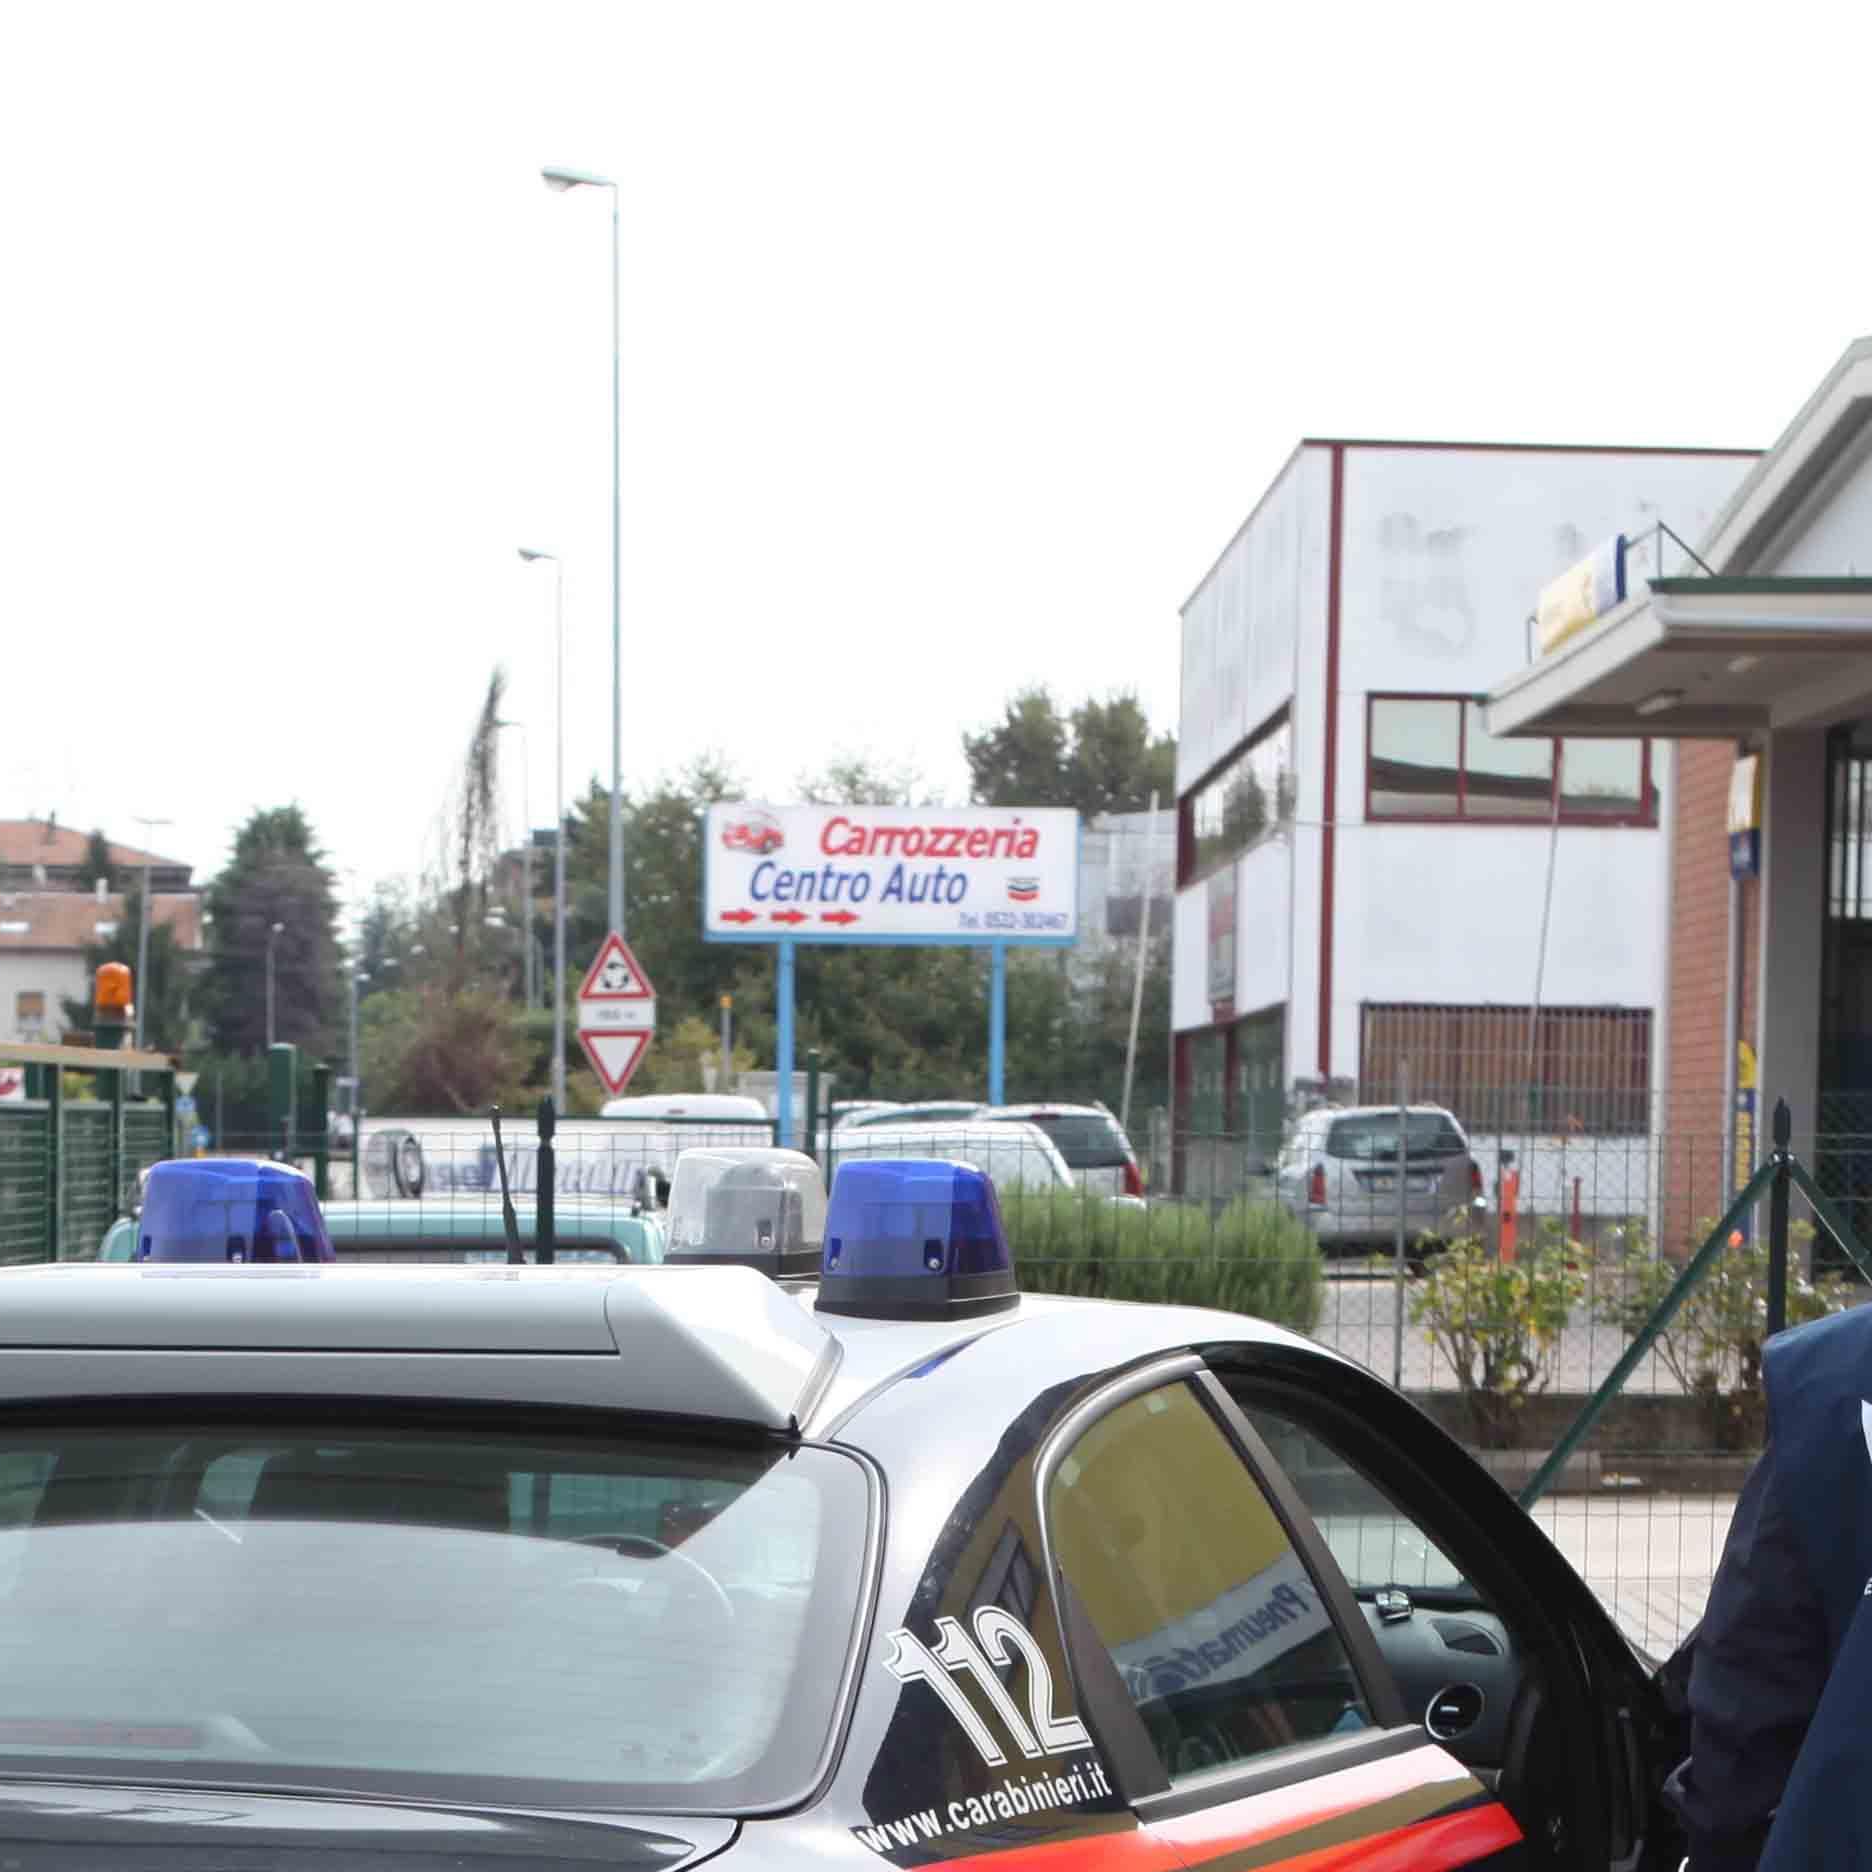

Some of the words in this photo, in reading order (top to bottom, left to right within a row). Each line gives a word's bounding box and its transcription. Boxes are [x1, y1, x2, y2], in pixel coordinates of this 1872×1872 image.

[819, 817, 1040, 859] Carrozzeria
[749, 861, 872, 904] Centro
[879, 862, 969, 904] Auto
[882, 1604, 1094, 1768] 112
[857, 1761, 1113, 1853] www.carabinieri.it
